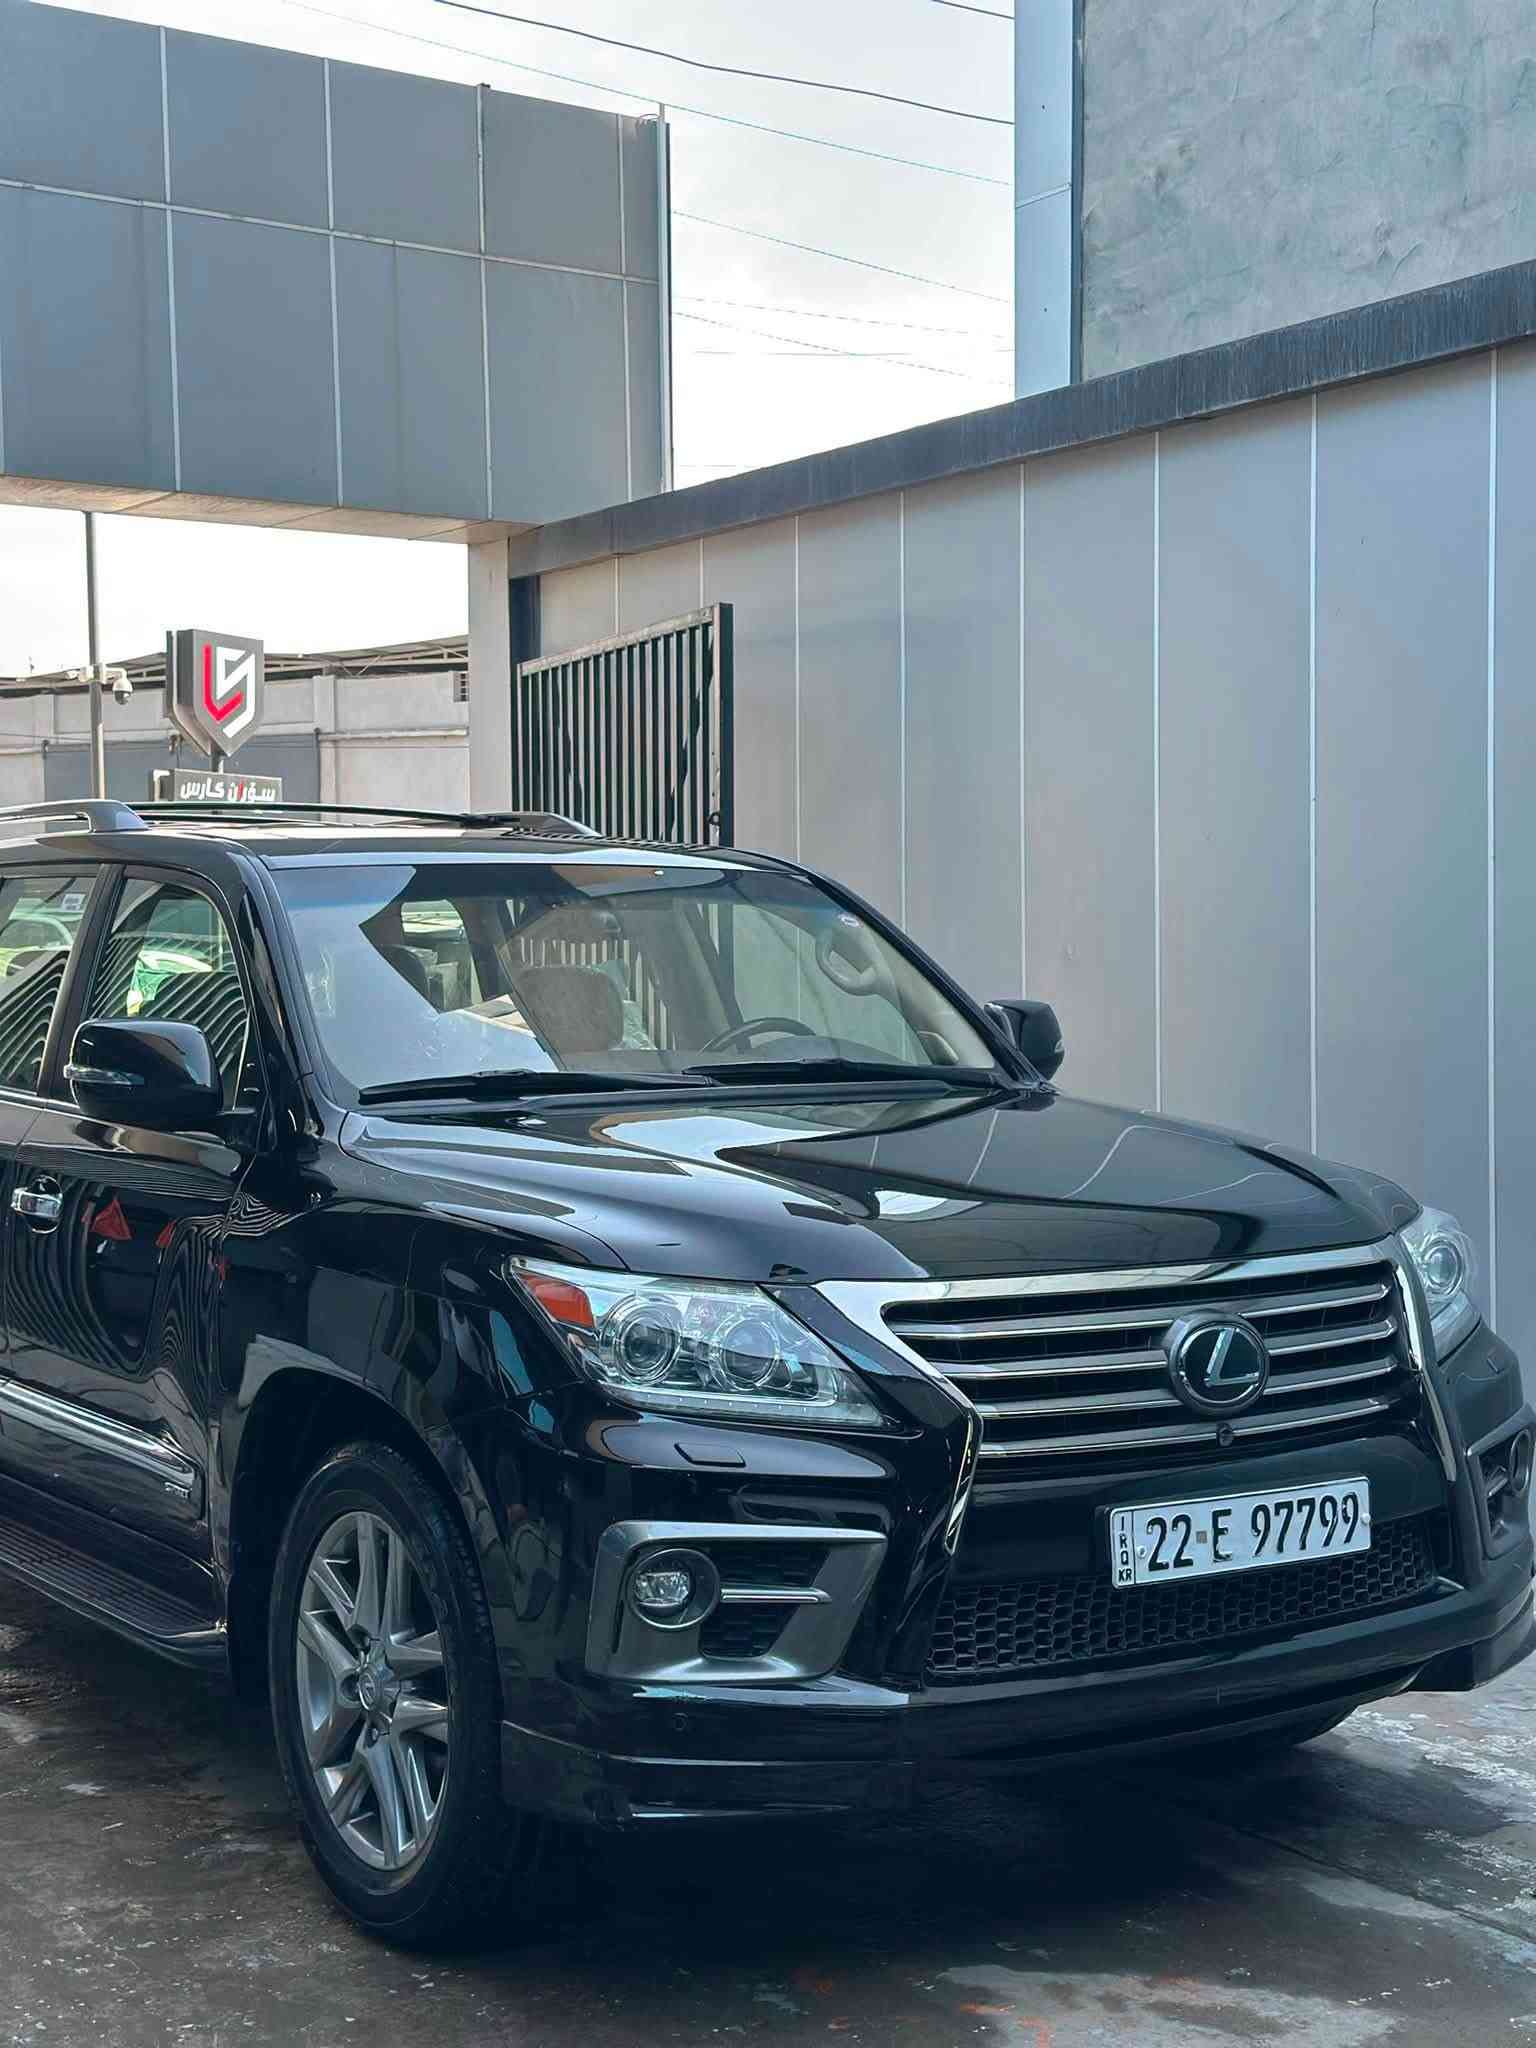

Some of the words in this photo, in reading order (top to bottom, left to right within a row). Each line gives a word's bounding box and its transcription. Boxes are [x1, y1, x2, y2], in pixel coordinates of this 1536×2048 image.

[1146, 1513, 1194, 1572] 22
[1211, 1508, 1233, 1563] E
[1250, 1491, 1360, 1557] 97799
[1118, 1568, 1132, 1583] KR
